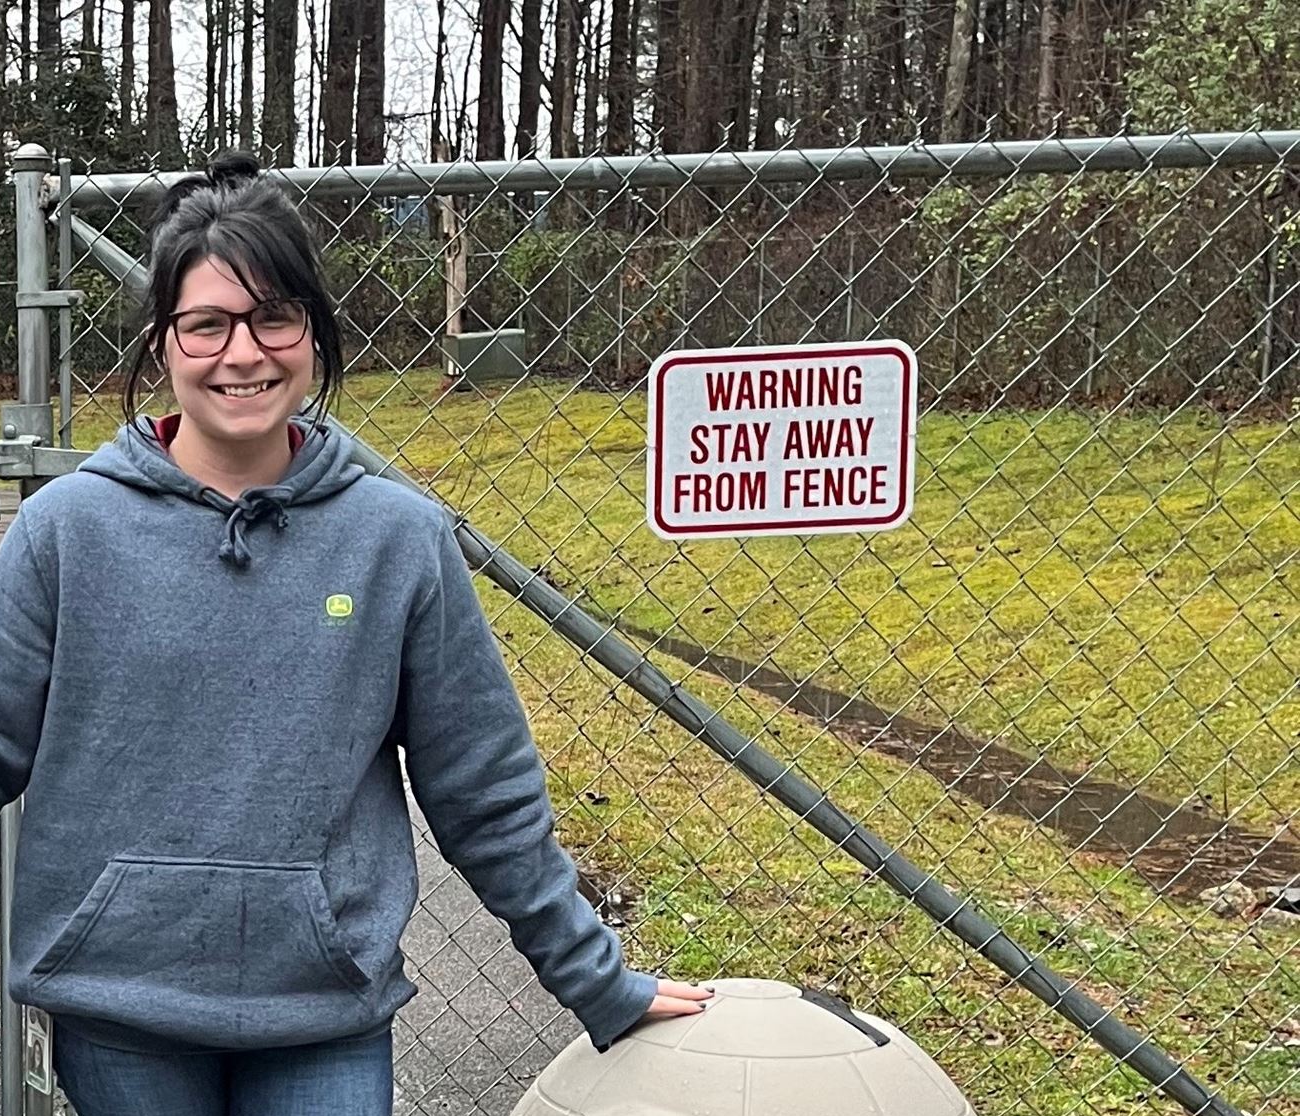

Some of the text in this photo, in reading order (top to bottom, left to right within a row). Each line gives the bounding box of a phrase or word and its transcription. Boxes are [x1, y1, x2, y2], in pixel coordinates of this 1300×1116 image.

[705, 365, 863, 412] WARNING
[690, 417, 874, 464] STAY AWAY
[674, 465, 888, 513] FROM FENCE
